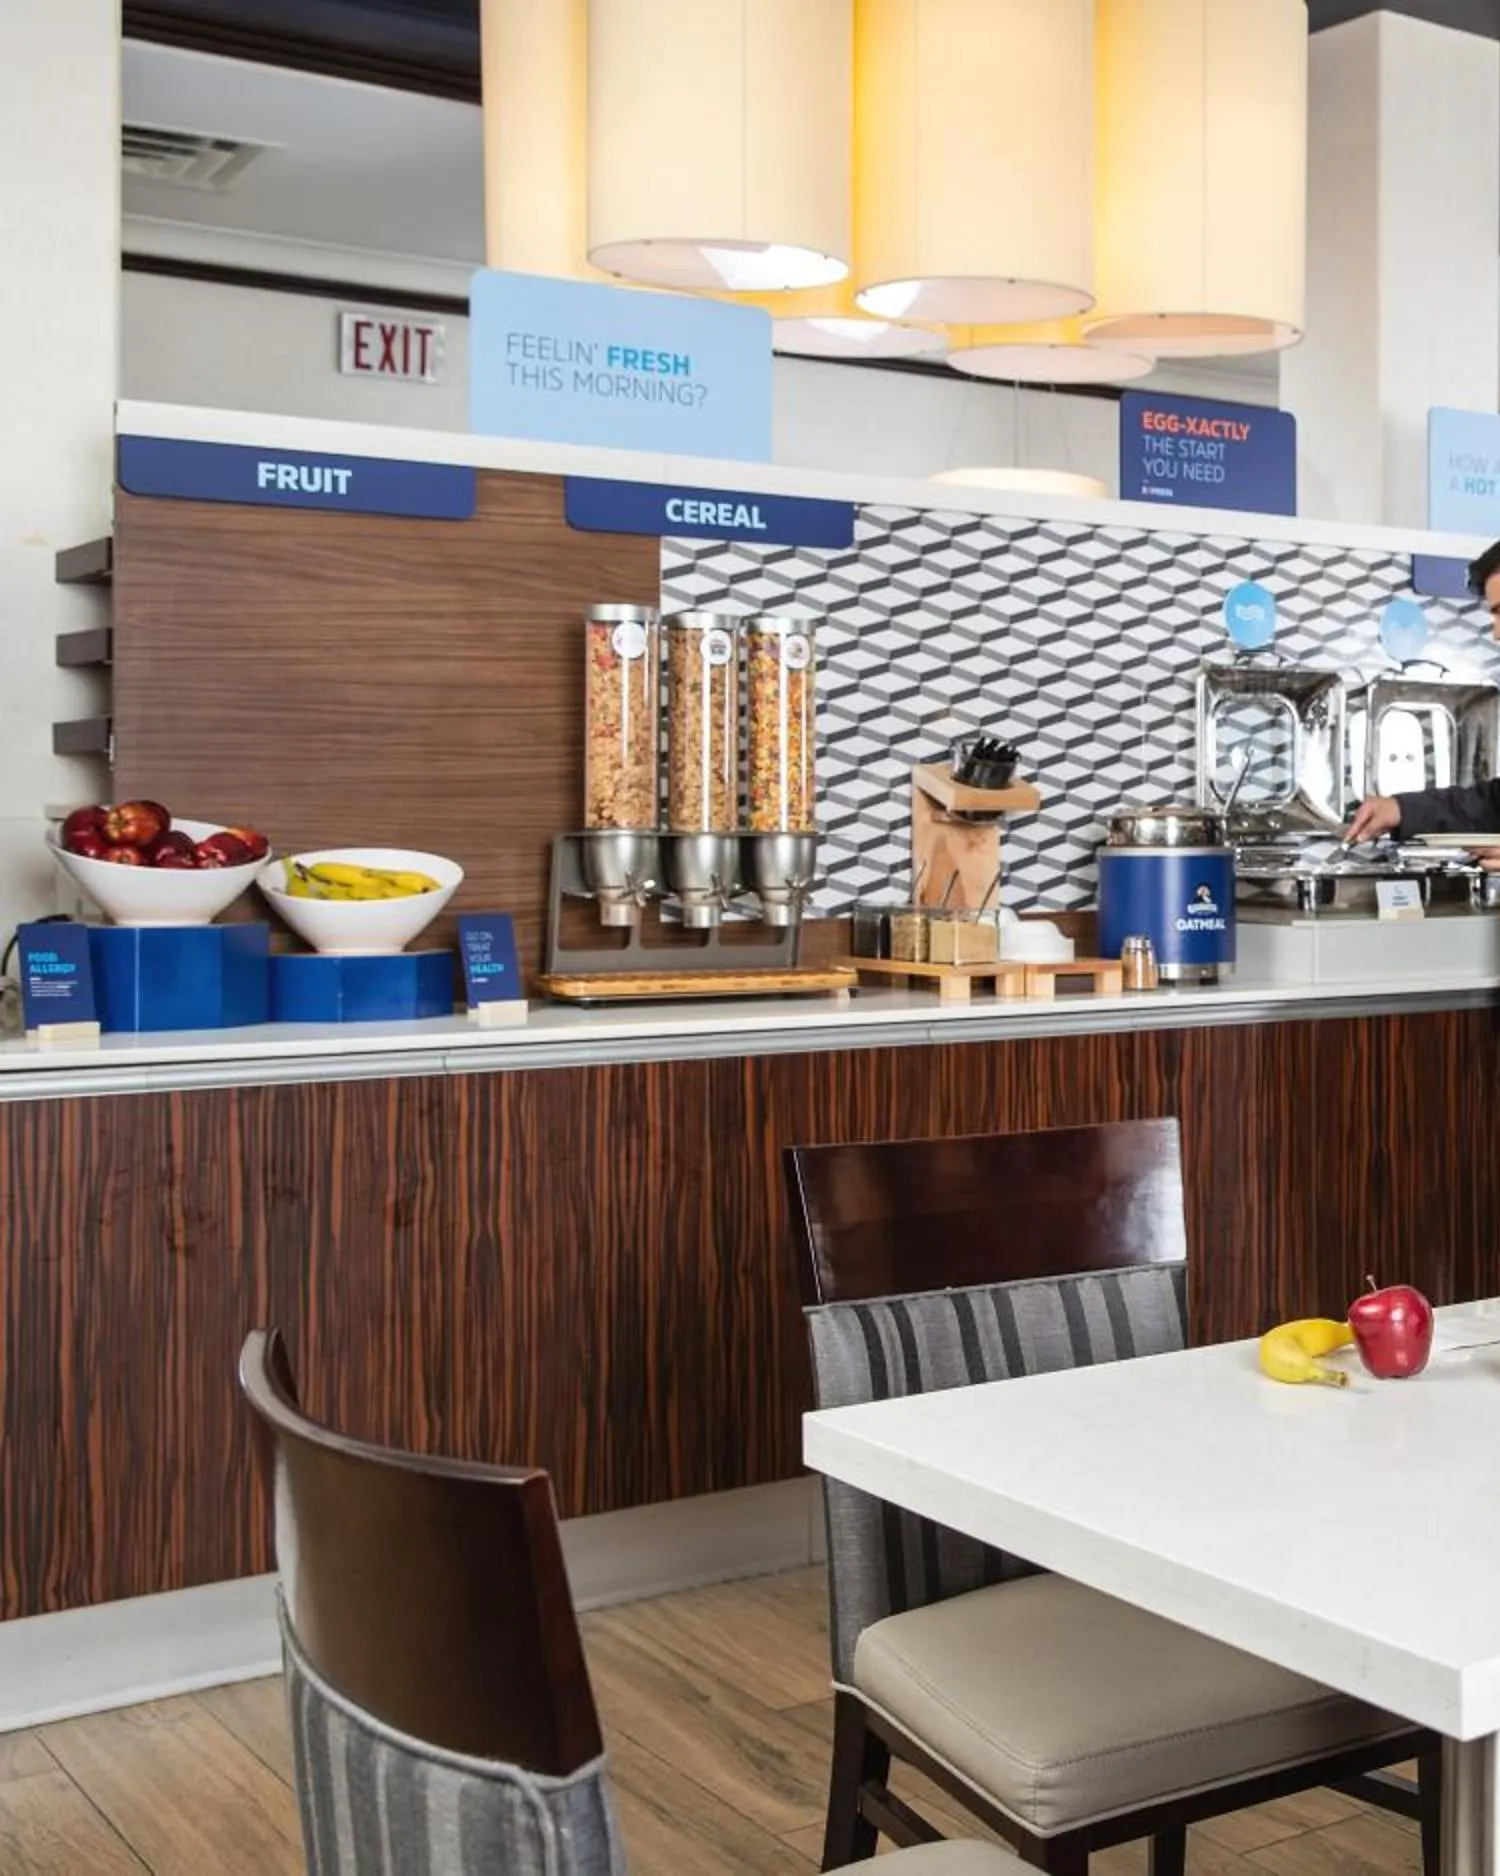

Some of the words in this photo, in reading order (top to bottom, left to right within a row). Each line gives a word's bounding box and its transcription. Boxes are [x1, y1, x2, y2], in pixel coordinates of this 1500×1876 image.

[354, 320, 434, 378] EXIT
[506, 332, 599, 365] FEELIN'
[607, 345, 690, 377] FRESH
[505, 362, 563, 392] THIS
[573, 370, 709, 409] MORNING?
[1142, 411, 1251, 441] EGG-XACTLY
[1142, 434, 1174, 456] THE
[1178, 438, 1226, 461] START
[1142, 457, 1178, 479] YOU
[1183, 462, 1225, 483] NEED
[1448, 451, 1489, 475] HOW
[258, 461, 352, 495] FRUIT
[1449, 475, 1460, 491] A
[1463, 476, 1496, 496] HOT
[665, 498, 767, 529] CEREAL
[1176, 917, 1226, 931] OATMEAL
[28, 952, 58, 963] FOOD
[30, 963, 76, 974] ALLERGY
[470, 963, 504, 974] HEALTH
